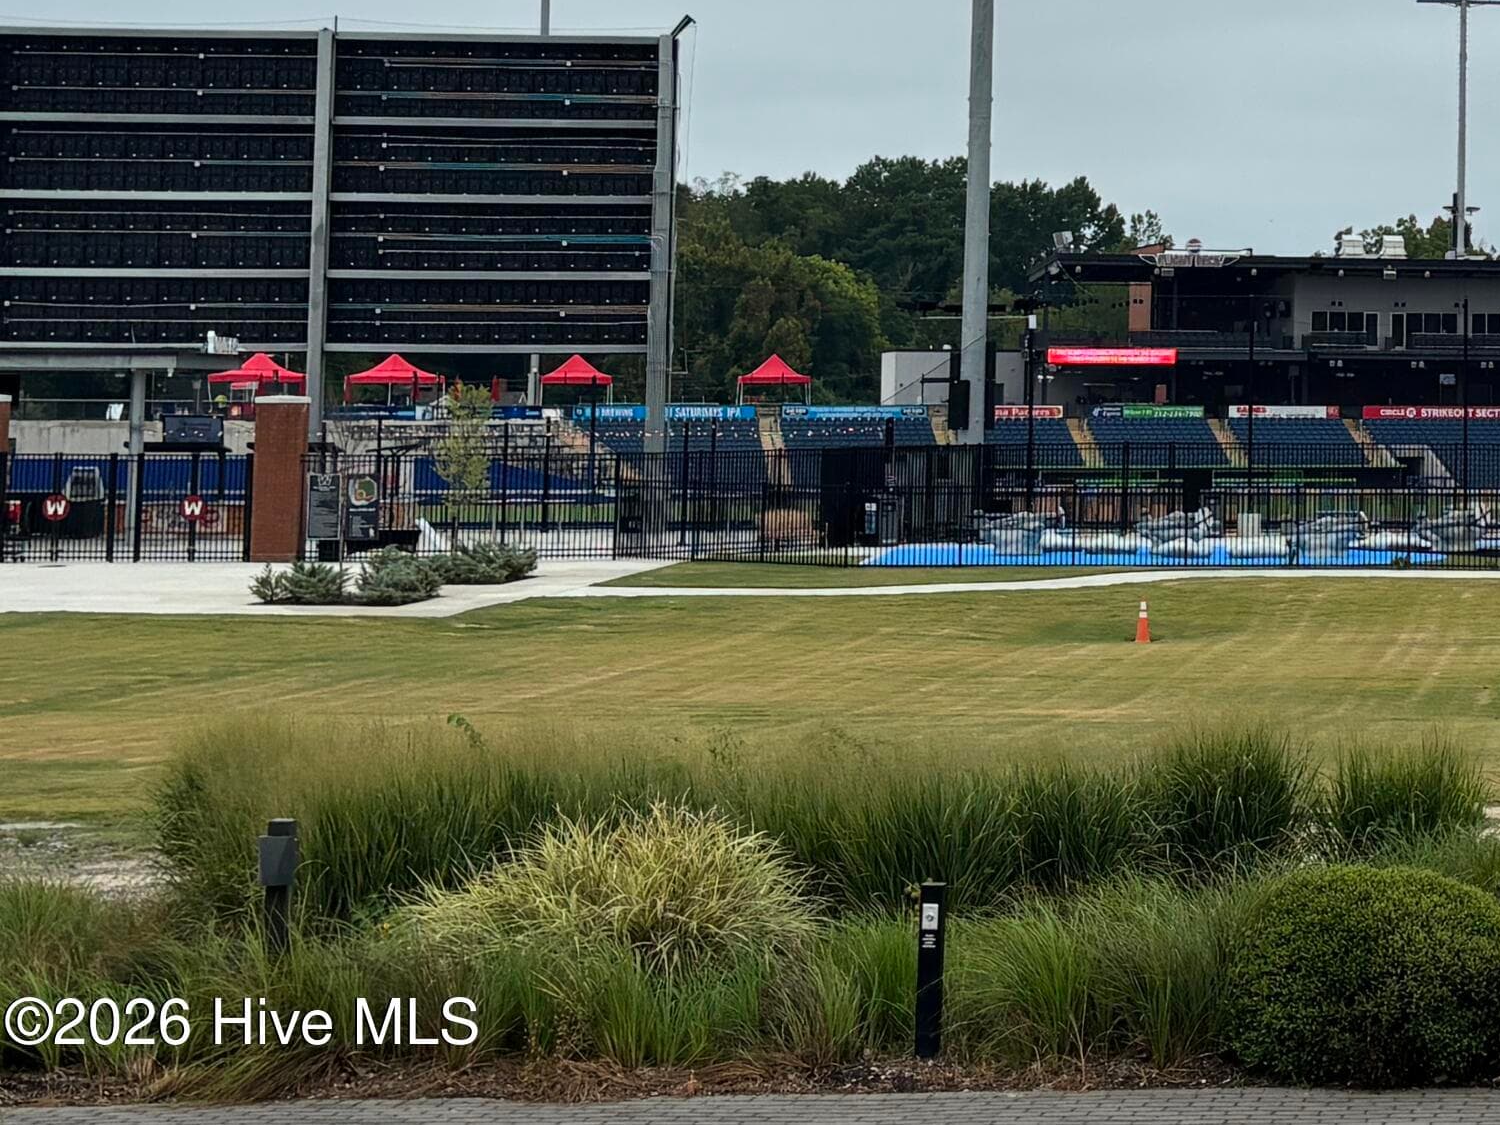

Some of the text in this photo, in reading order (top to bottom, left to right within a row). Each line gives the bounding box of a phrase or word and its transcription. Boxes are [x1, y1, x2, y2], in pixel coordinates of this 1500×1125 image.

[674, 407, 723, 418] SATURDAYS
[1012, 407, 1050, 416] Pacers
[1380, 408, 1405, 416] CIRCLE
[1421, 407, 1475, 418] STRIKEOT
[46, 500, 66, 515] W
[183, 500, 202, 515] W
